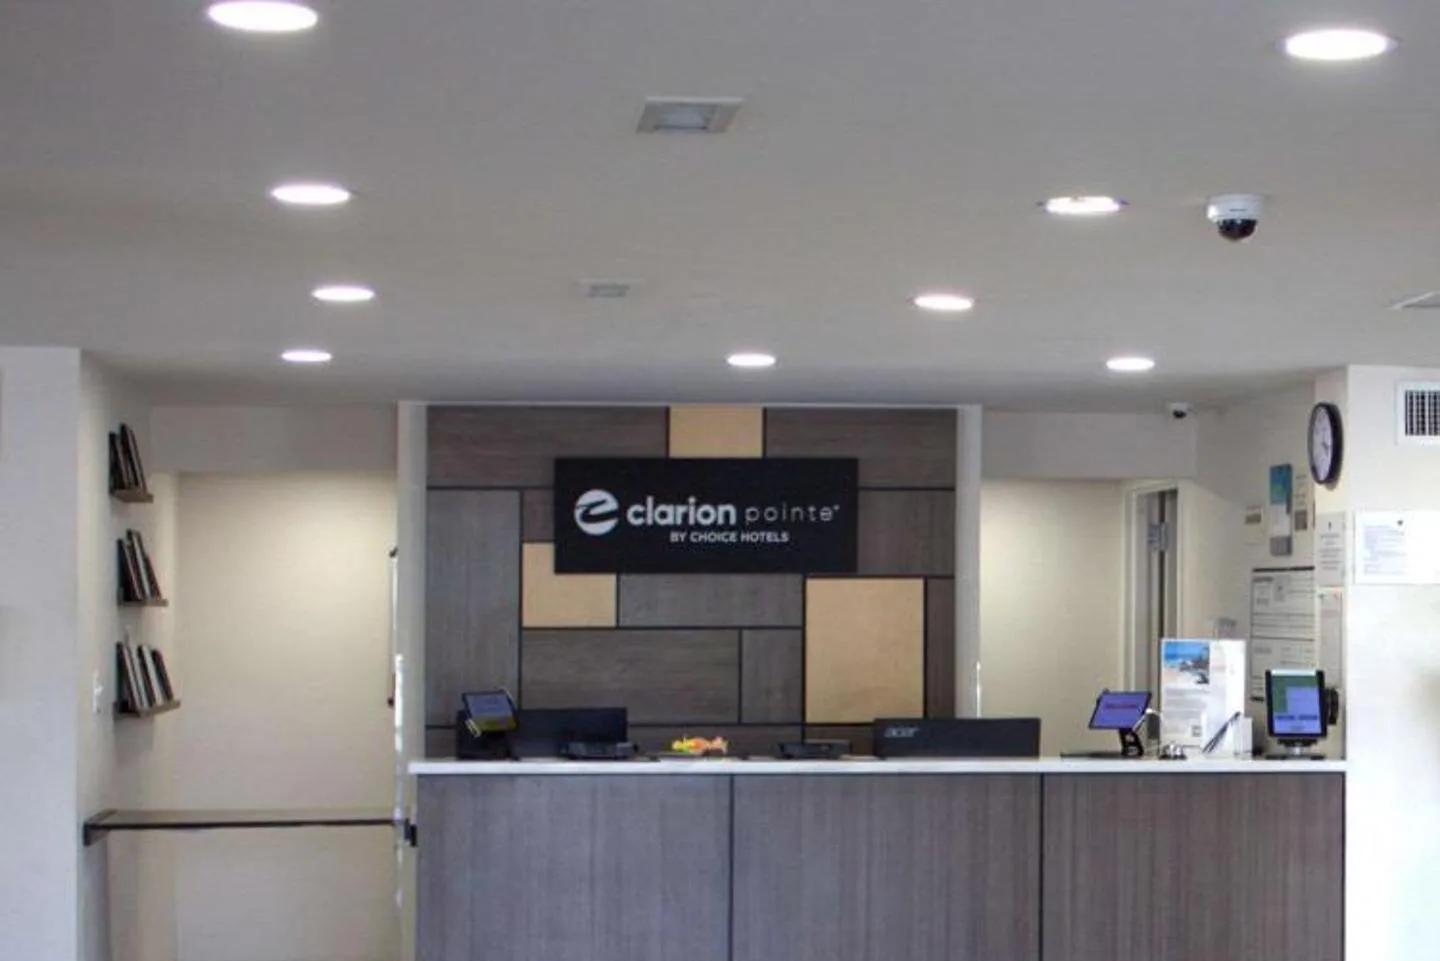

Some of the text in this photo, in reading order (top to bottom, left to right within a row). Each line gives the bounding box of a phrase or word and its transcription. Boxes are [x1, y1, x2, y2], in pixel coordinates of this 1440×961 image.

[626, 495, 833, 526] clarion pointe
[669, 531, 789, 542] BY CHOICE HOTELS
[884, 727, 919, 738] acer
